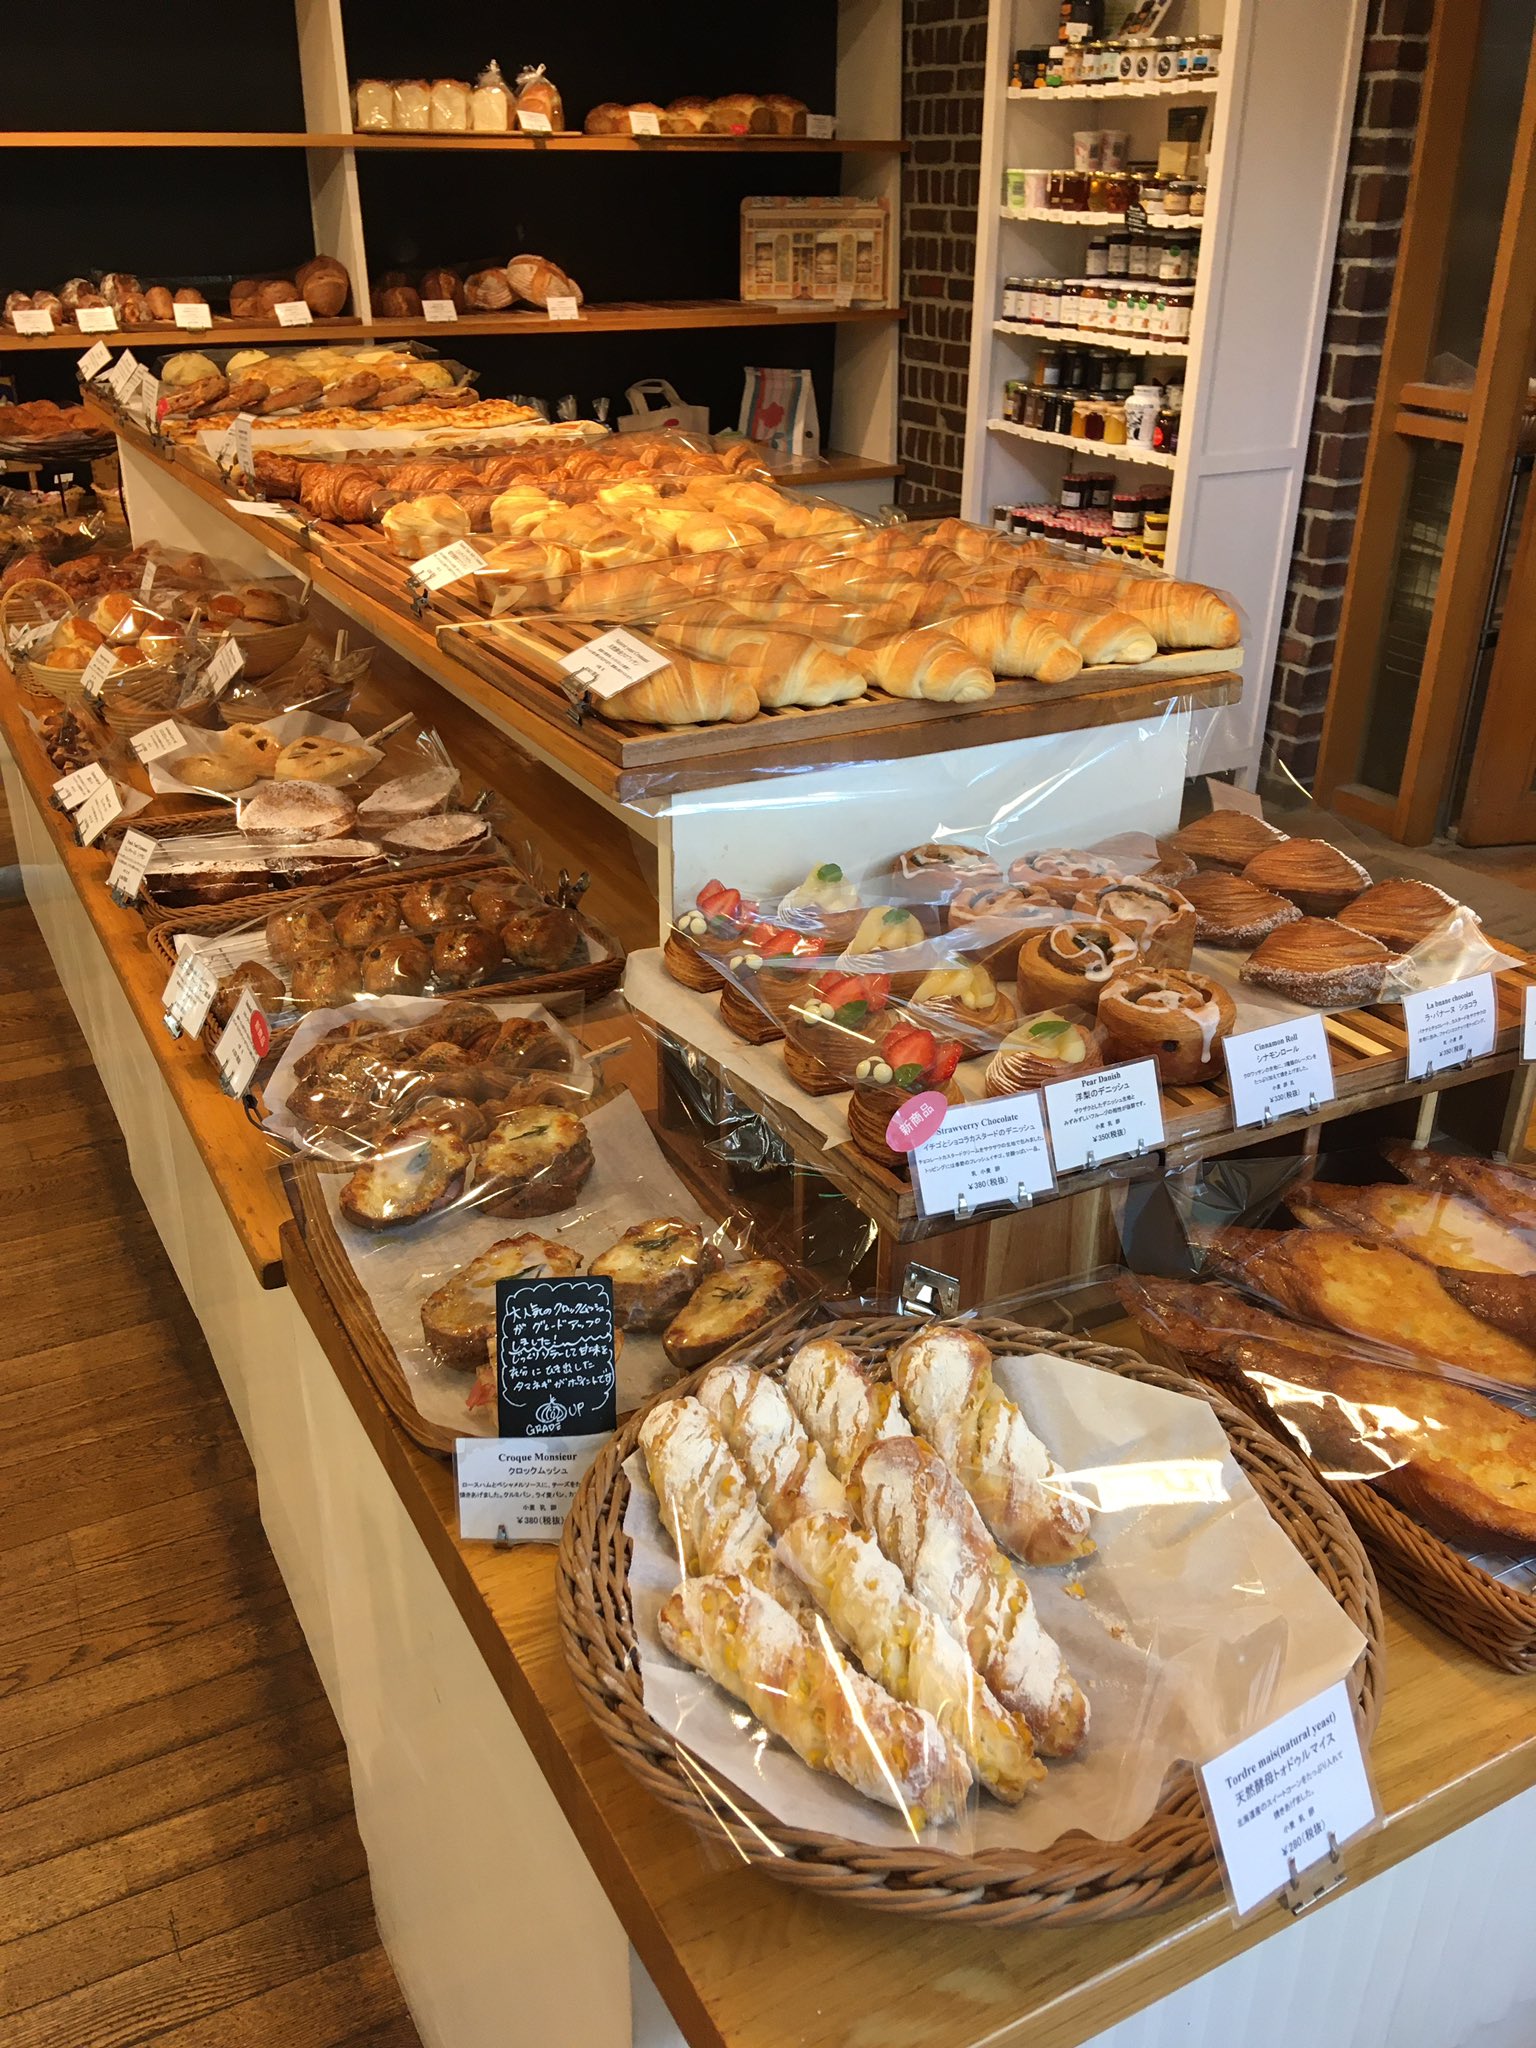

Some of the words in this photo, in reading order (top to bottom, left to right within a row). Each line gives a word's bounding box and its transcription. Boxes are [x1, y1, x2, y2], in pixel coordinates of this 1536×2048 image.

[1451, 990, 1474, 1002] chocolat
[1458, 999, 1478, 1011] ショコラ
[1253, 1038, 1285, 1052] Cinnamon
[1285, 1033, 1298, 1043] Roll
[1256, 1045, 1300, 1063] シナモンロール
[1081, 1079, 1097, 1088] Pear
[1098, 1071, 1121, 1083] Danish
[1075, 1082, 1130, 1102] 洋梨のデニッシュ
[899, 1103, 935, 1136] 新商品
[980, 1114, 1019, 1127] Chocolate
[921, 1124, 1036, 1152] イチゴとショコラカスタードのデニッシュ
[967, 1175, 1009, 1190] ¥380(税抜)
[510, 1302, 605, 1323] 大人気のクロックムッシュ
[568, 1401, 585, 1417] UP
[525, 1421, 562, 1436] GRADE
[498, 1452, 533, 1464] Croque
[534, 1452, 578, 1462] Monsieur
[508, 1466, 569, 1475] クロックムッシュ
[516, 1516, 565, 1525] ¥380(税抜)
[1224, 1764, 1256, 1789] Tordre
[1257, 1726, 1311, 1769] mais(natural
[1311, 1711, 1336, 1737] yeast)
[1237, 1751, 1343, 1828] 北海道産のスイートコーンをたっぷり入れて
[1273, 1789, 1314, 1820] 焼きあげました。
[1283, 1820, 1295, 1833] 小麦
[1281, 1819, 1326, 1857] ¥280(税抜)
